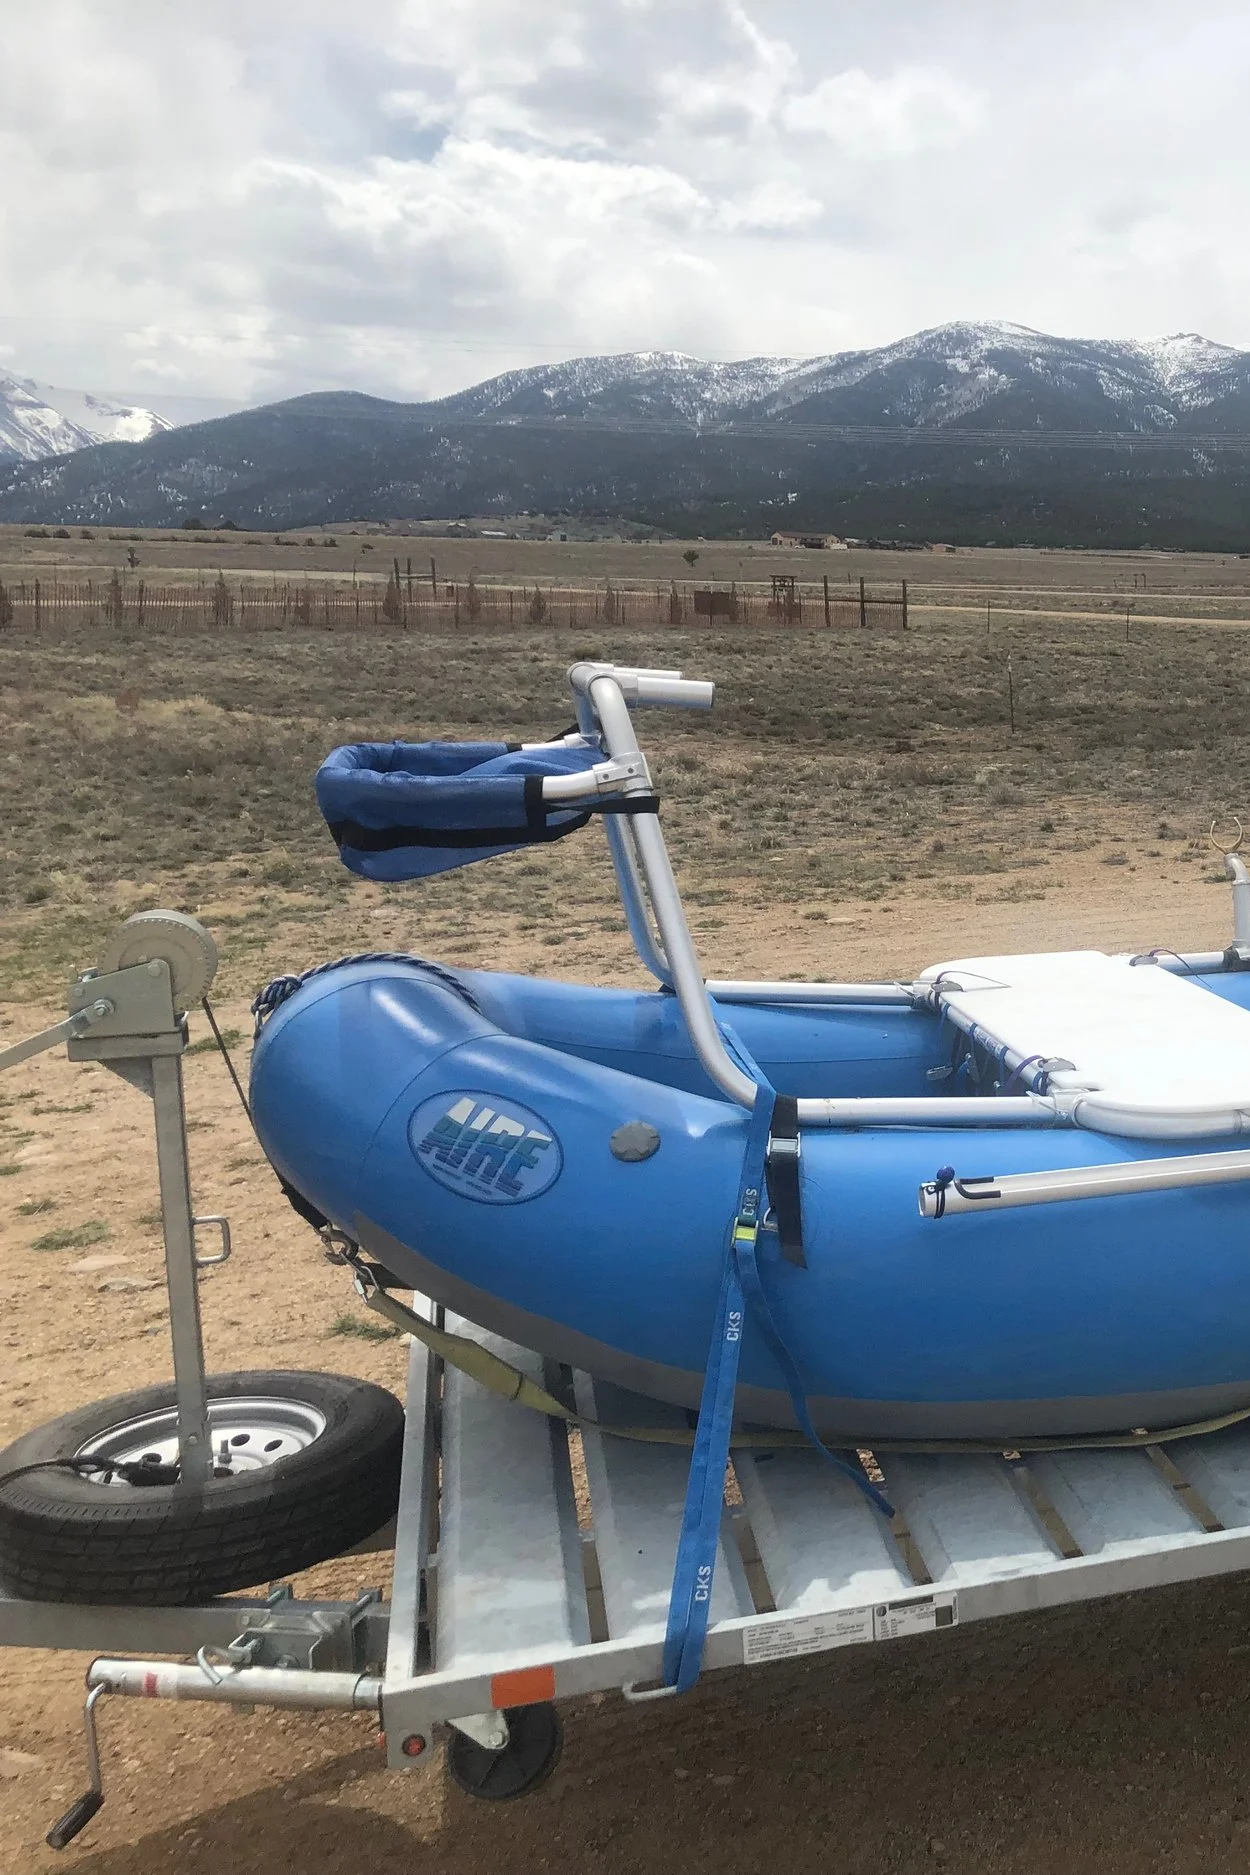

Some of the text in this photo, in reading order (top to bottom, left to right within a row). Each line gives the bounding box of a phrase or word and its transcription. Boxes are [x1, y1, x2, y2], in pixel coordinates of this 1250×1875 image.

[418, 1097, 552, 1197] AIRE
[726, 1311, 741, 1341] CKS
[695, 1565, 711, 1601] CKS
